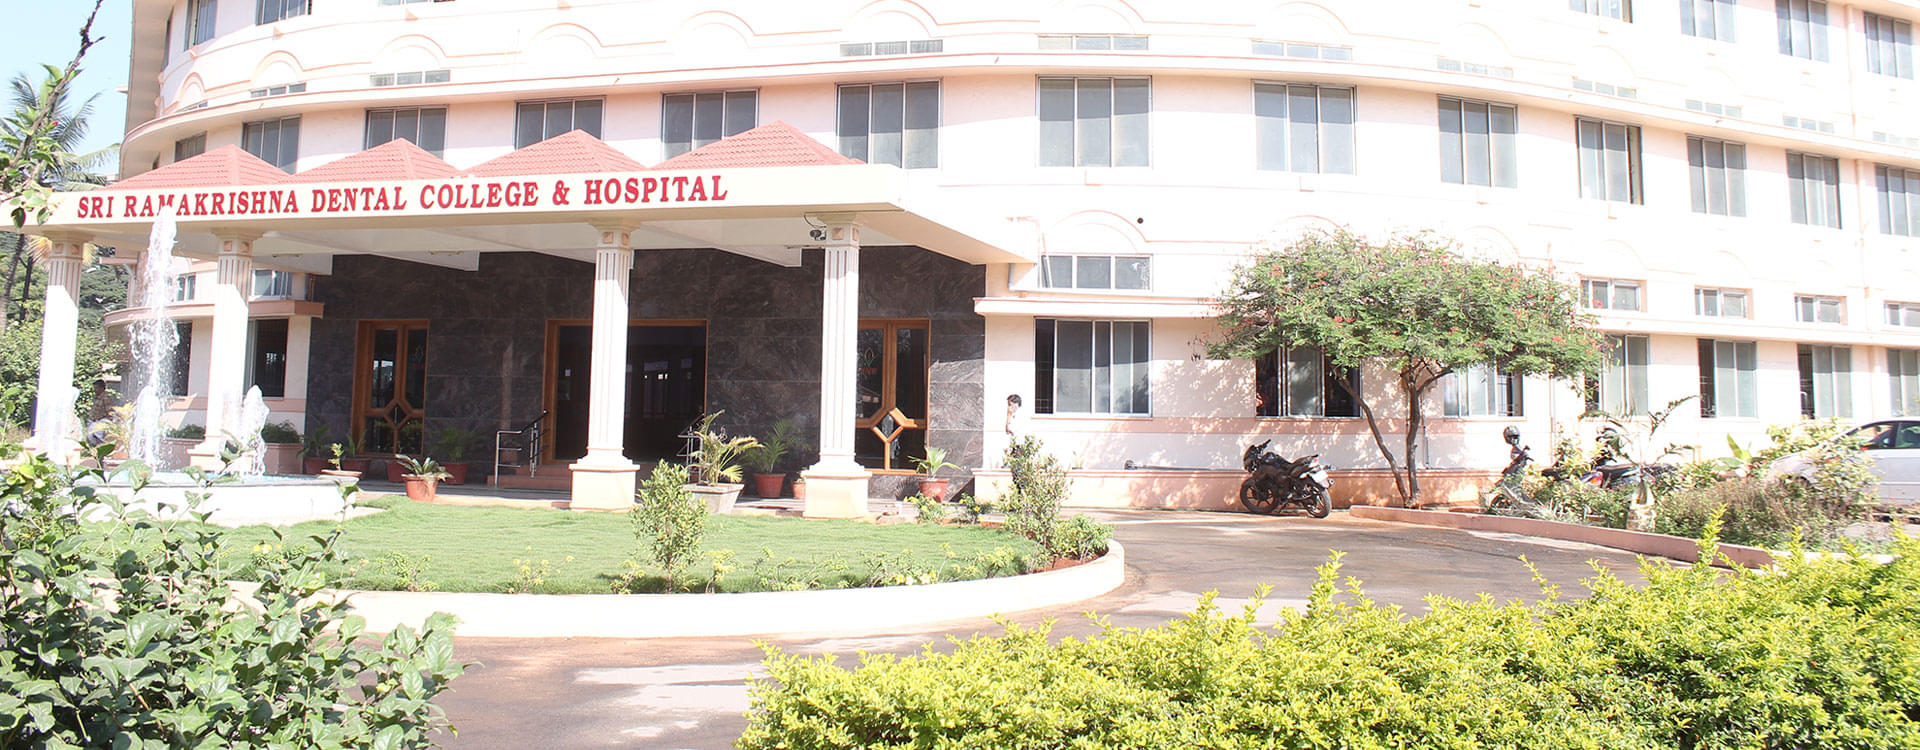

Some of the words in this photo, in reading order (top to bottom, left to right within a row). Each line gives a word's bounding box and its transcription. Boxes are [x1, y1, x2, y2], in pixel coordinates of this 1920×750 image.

[77, 196, 114, 218] SRI
[124, 190, 299, 217] RAMAKRISHNA
[311, 186, 407, 212] DENTAL
[420, 181, 539, 209] COLLEGE
[552, 180, 571, 206] &
[584, 175, 729, 204] HOSPITAL
